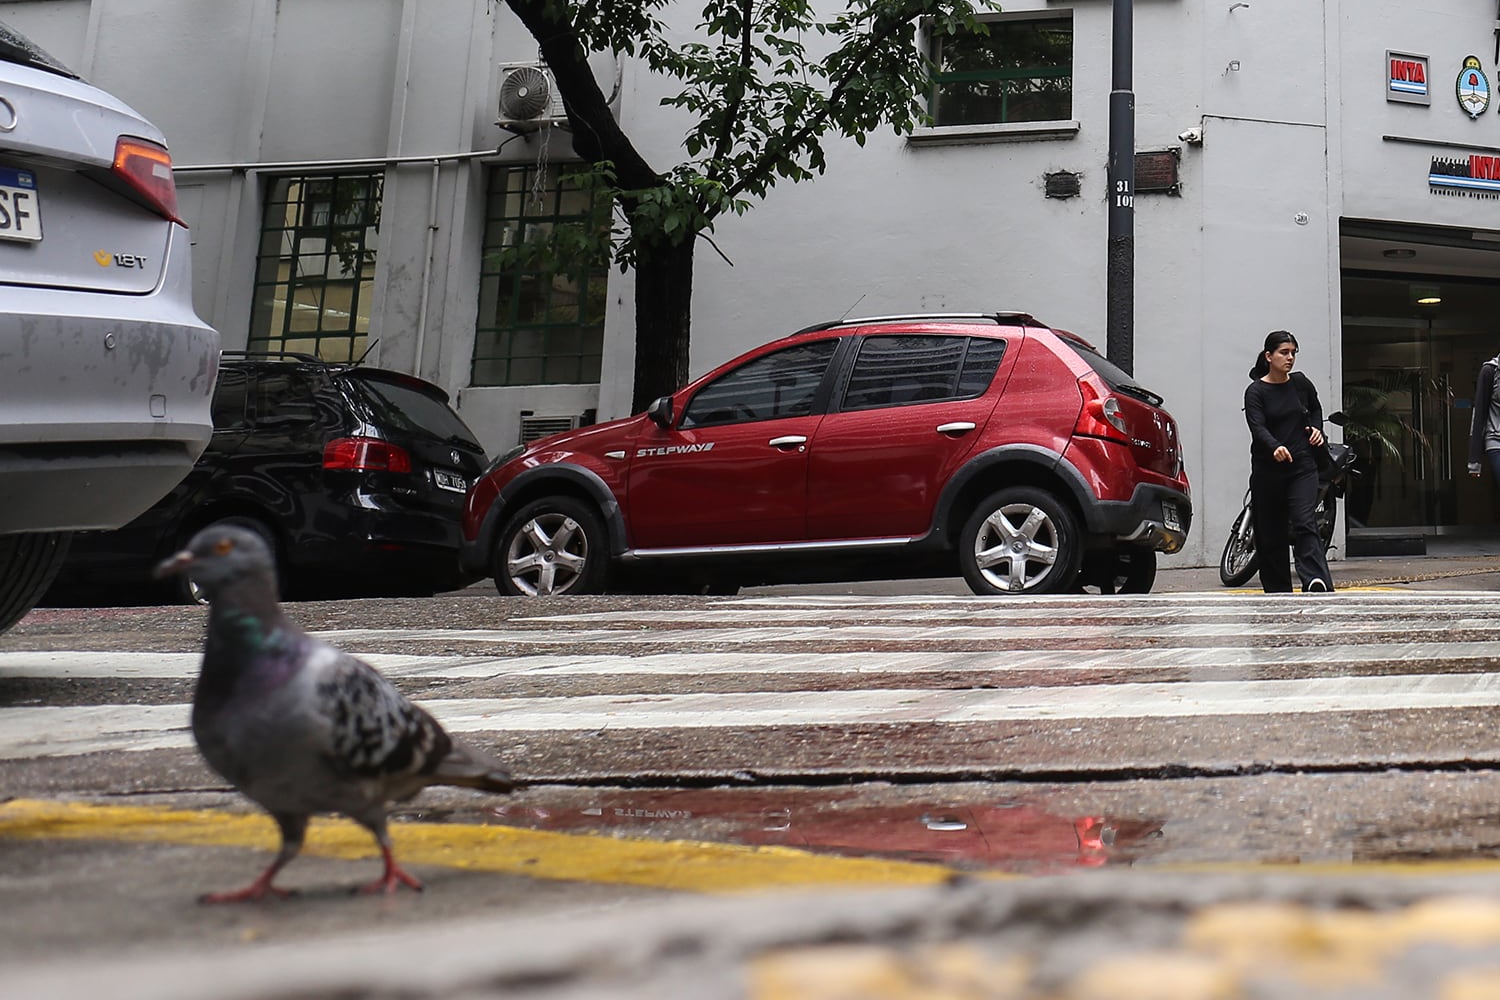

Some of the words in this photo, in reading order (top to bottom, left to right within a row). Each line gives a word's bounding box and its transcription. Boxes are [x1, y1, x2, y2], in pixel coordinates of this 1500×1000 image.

[1390, 59, 1426, 84] INTA
[1116, 180, 1129, 193] 31
[636, 443, 706, 458] STEPWAY
